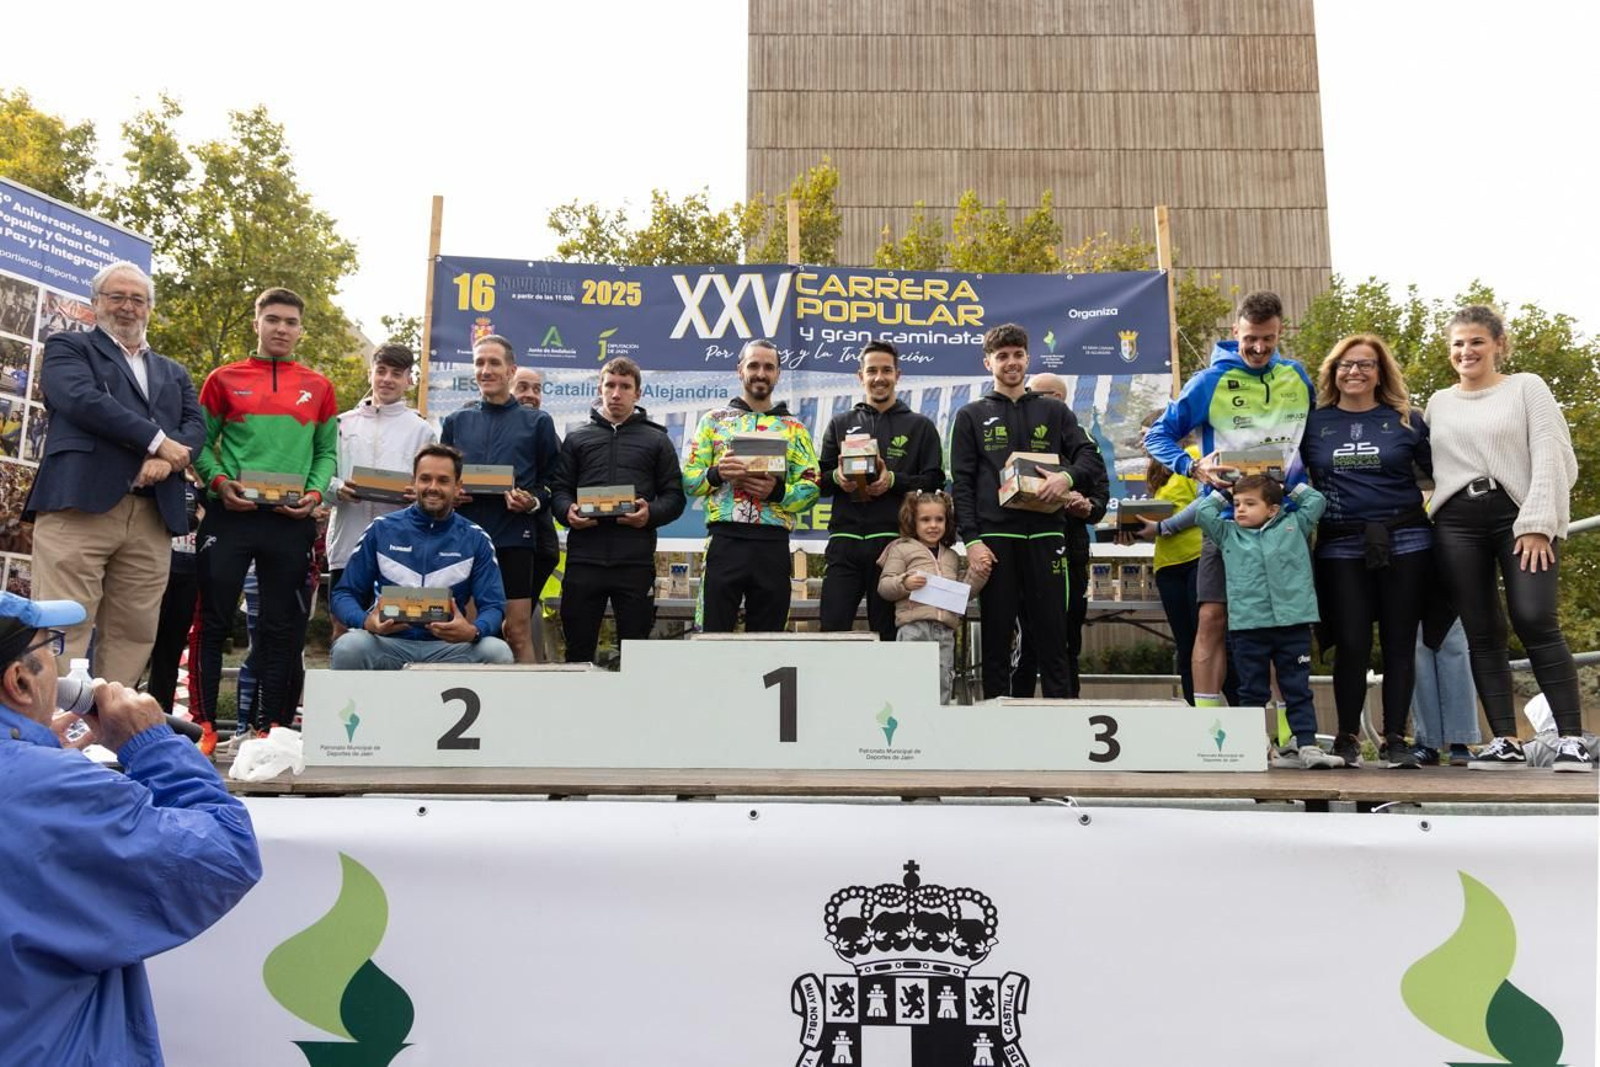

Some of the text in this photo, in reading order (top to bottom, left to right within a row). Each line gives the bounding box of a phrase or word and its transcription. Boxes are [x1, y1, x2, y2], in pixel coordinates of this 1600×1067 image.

[13, 202, 82, 236] Aniversario
[84, 230, 98, 242] de
[99, 235, 110, 247] la
[4, 227, 28, 243] Paz
[28, 237, 37, 248] y
[37, 240, 50, 252] la
[51, 245, 108, 271] Integraci
[45, 230, 54, 240] y
[54, 233, 83, 251] Gran
[84, 244, 134, 263] Camin
[453, 273, 496, 313] 16
[582, 279, 642, 307] 2025
[669, 273, 794, 339] XXV
[796, 272, 979, 302] CARRERA
[796, 298, 985, 327] POPULAR
[1068, 307, 1118, 320] Organiza
[705, 345, 734, 362] Por
[799, 327, 985, 345] y gran caminata
[453, 377, 729, 402] IES Catalin Alejandría
[1333, 441, 1380, 456] 25
[437, 687, 481, 750] 2
[762, 666, 797, 743] 1
[1088, 715, 1121, 763] 3
[804, 983, 818, 1040] MUY NOBLE
[1003, 984, 1015, 1035] CASTILLA
